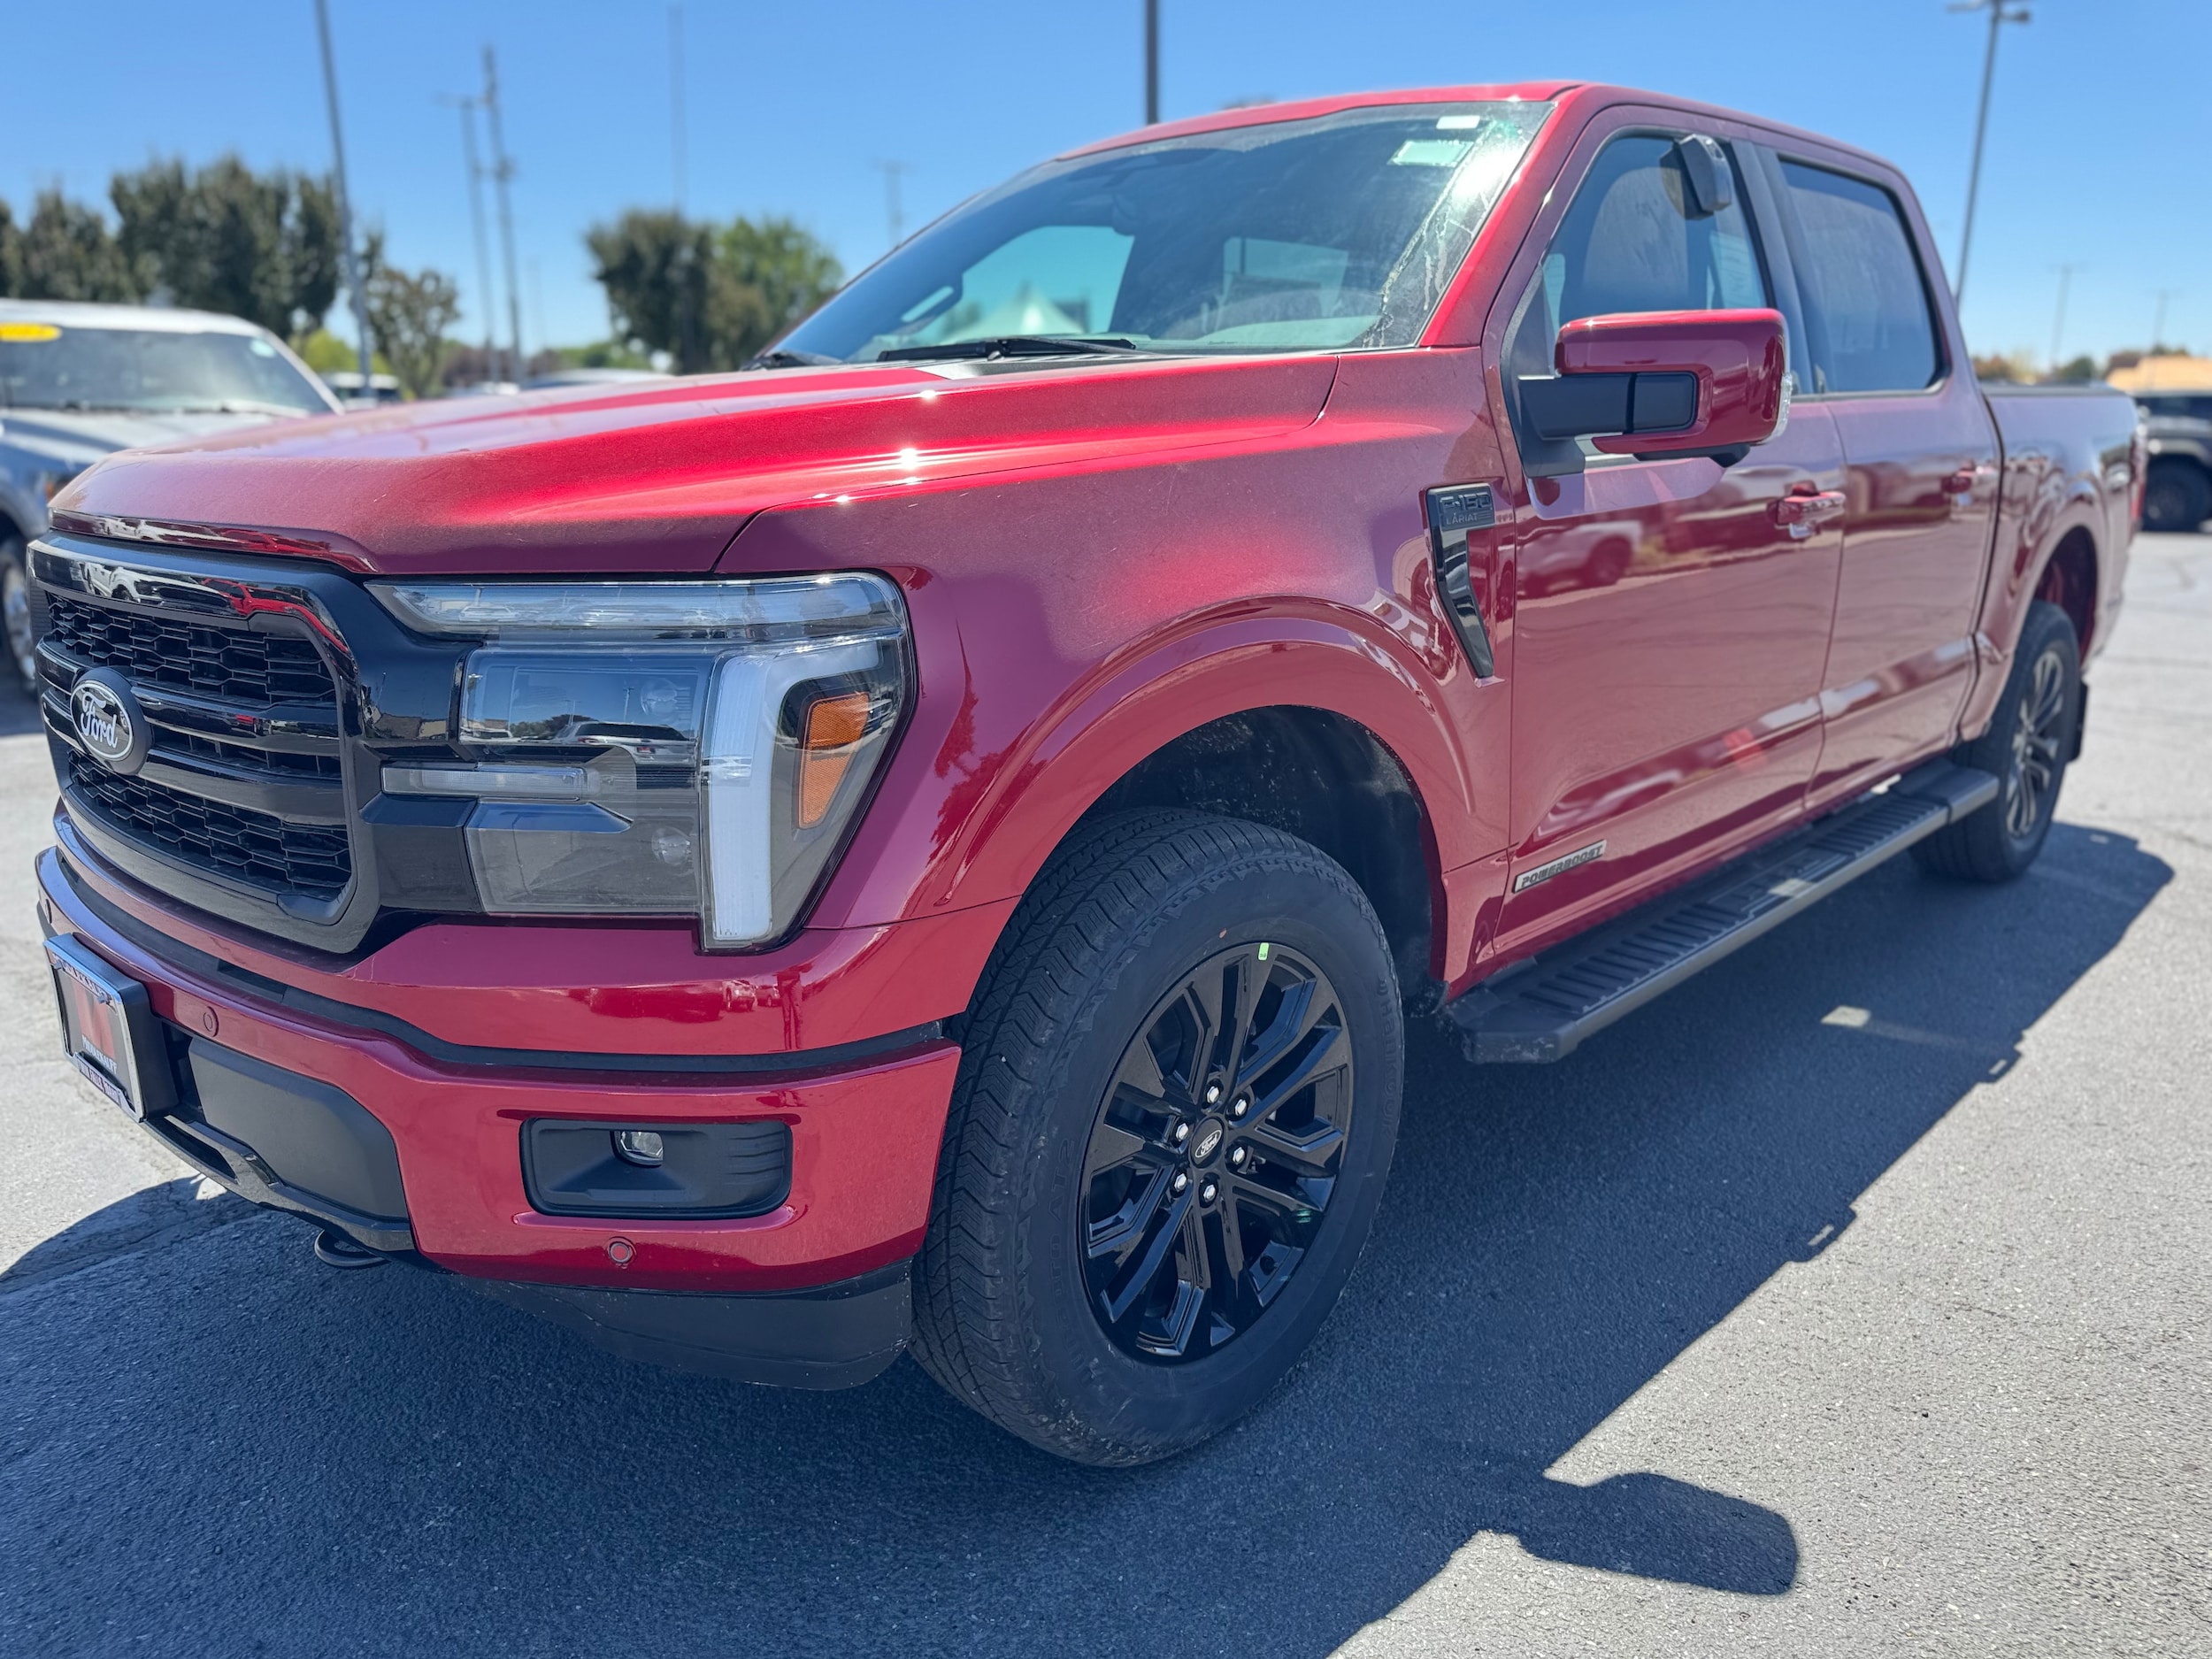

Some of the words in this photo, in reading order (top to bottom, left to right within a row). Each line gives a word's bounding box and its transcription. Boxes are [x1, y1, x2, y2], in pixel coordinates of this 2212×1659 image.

[1439, 492, 1492, 512] F-150
[1446, 513, 1479, 525] LARIAT
[81, 690, 119, 749] Ford
[1521, 844, 1603, 887] POWERBOOST
